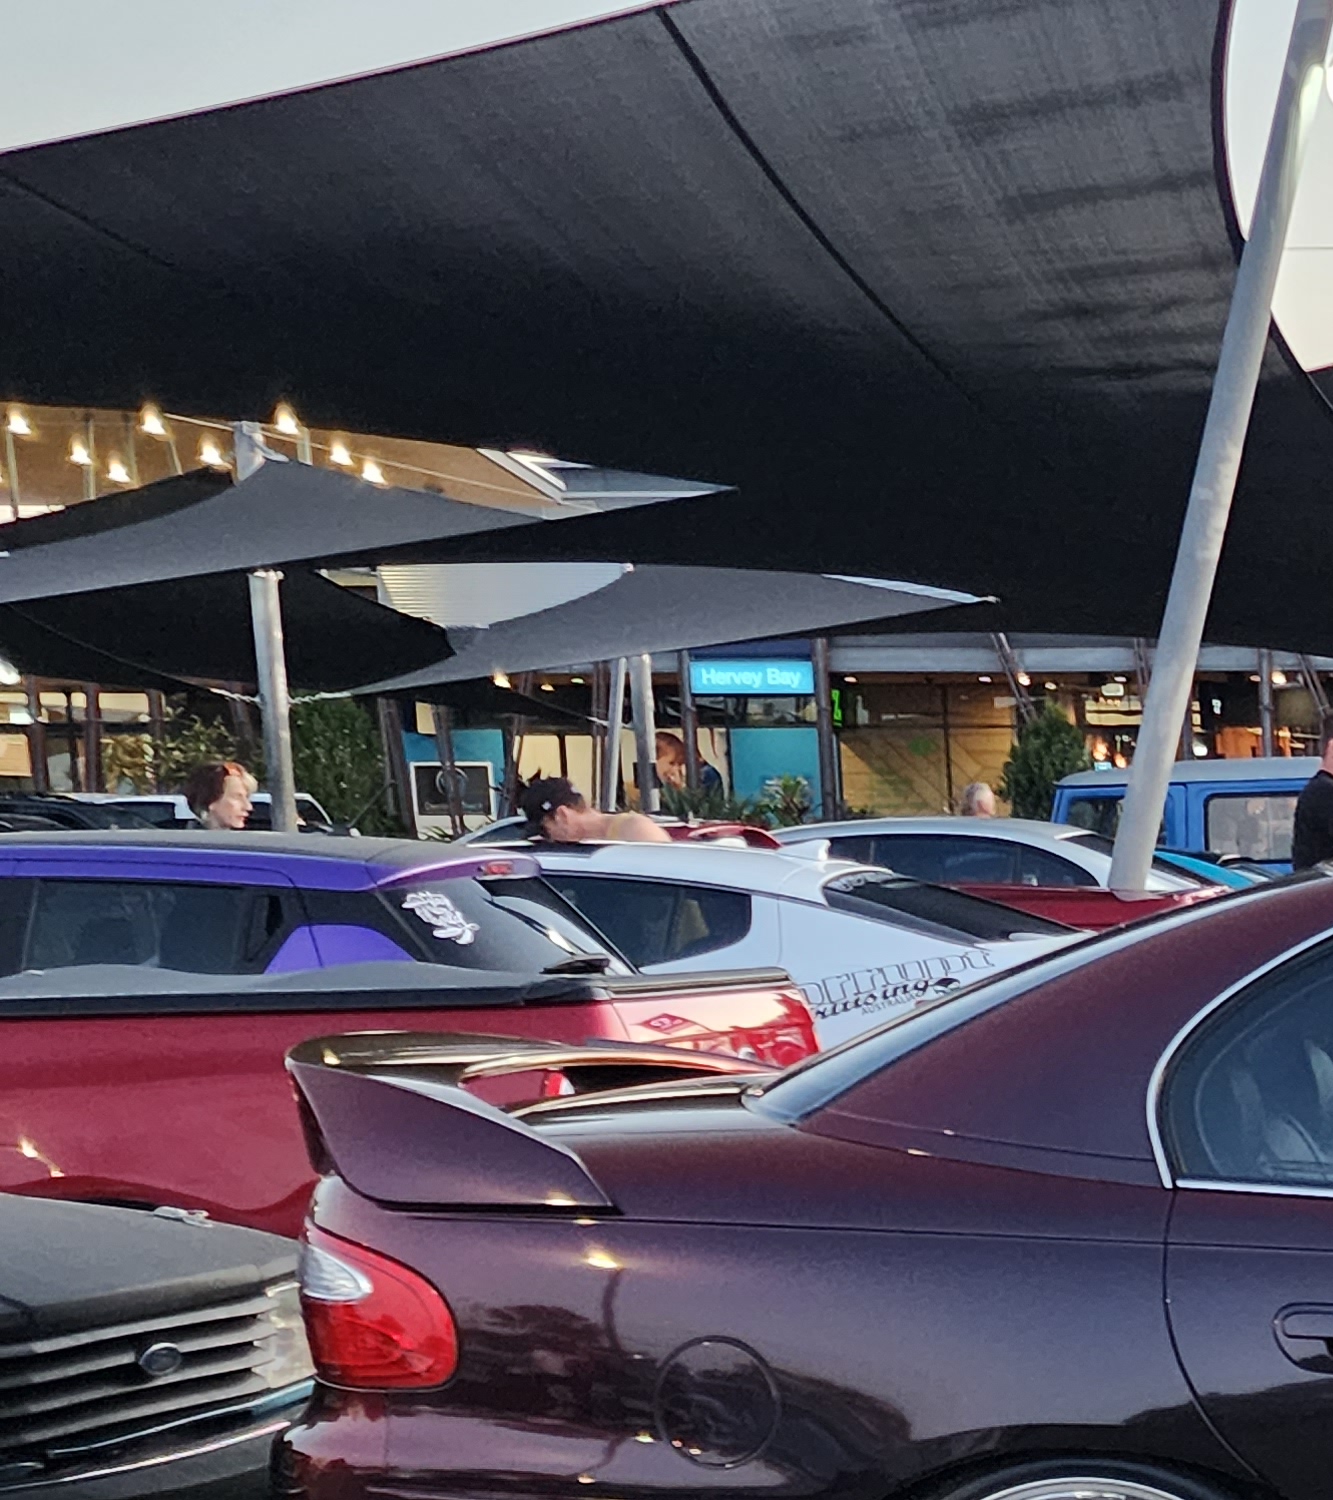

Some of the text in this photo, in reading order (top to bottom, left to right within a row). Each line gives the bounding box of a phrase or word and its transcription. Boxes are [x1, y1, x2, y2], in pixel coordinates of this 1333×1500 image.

[702, 668, 801, 688] Hervey Bay
[798, 950, 996, 1006] orrupt
